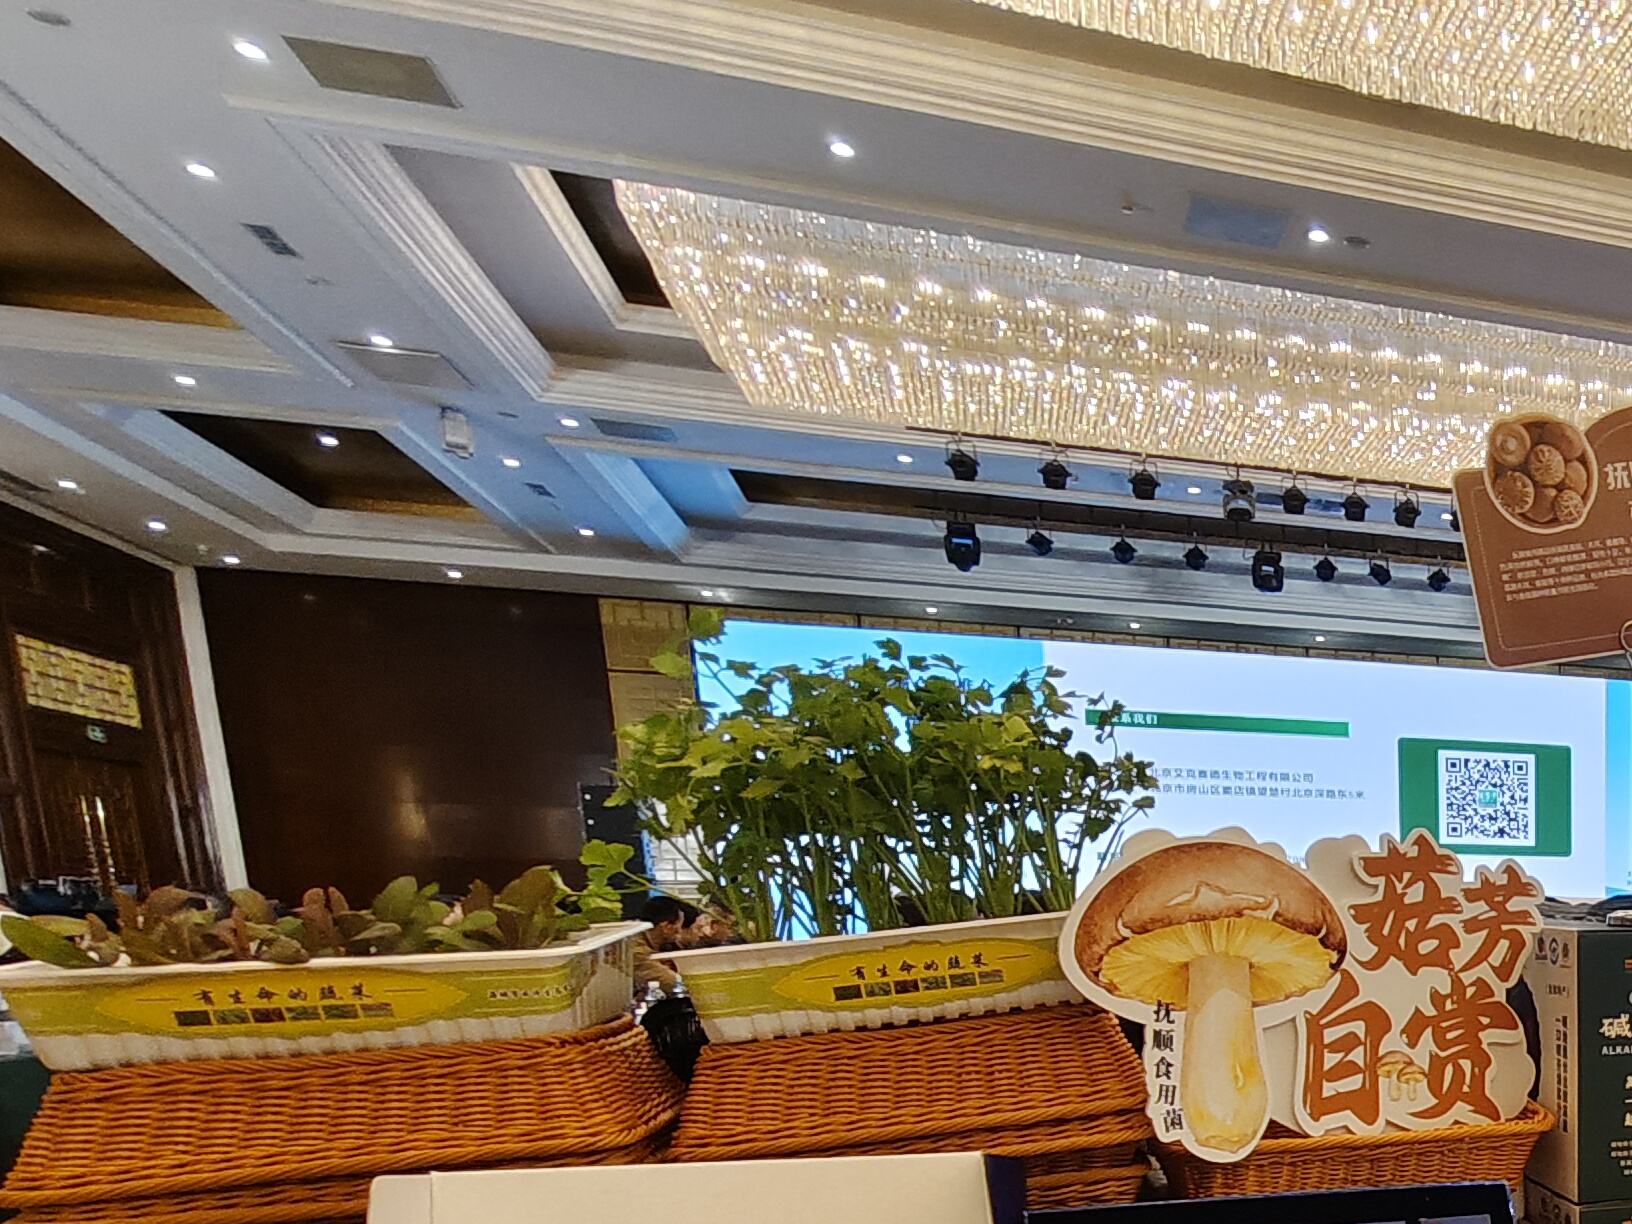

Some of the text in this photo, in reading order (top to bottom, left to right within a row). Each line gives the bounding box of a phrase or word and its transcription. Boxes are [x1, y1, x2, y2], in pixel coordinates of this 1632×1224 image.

[193, 981, 373, 1006] 有生命的蔬菜
[848, 952, 990, 982] 有生命的蔬菜
[1151, 1000, 1185, 1134] 抚顺食用菌
[1302, 970, 1520, 1126] 自赏
